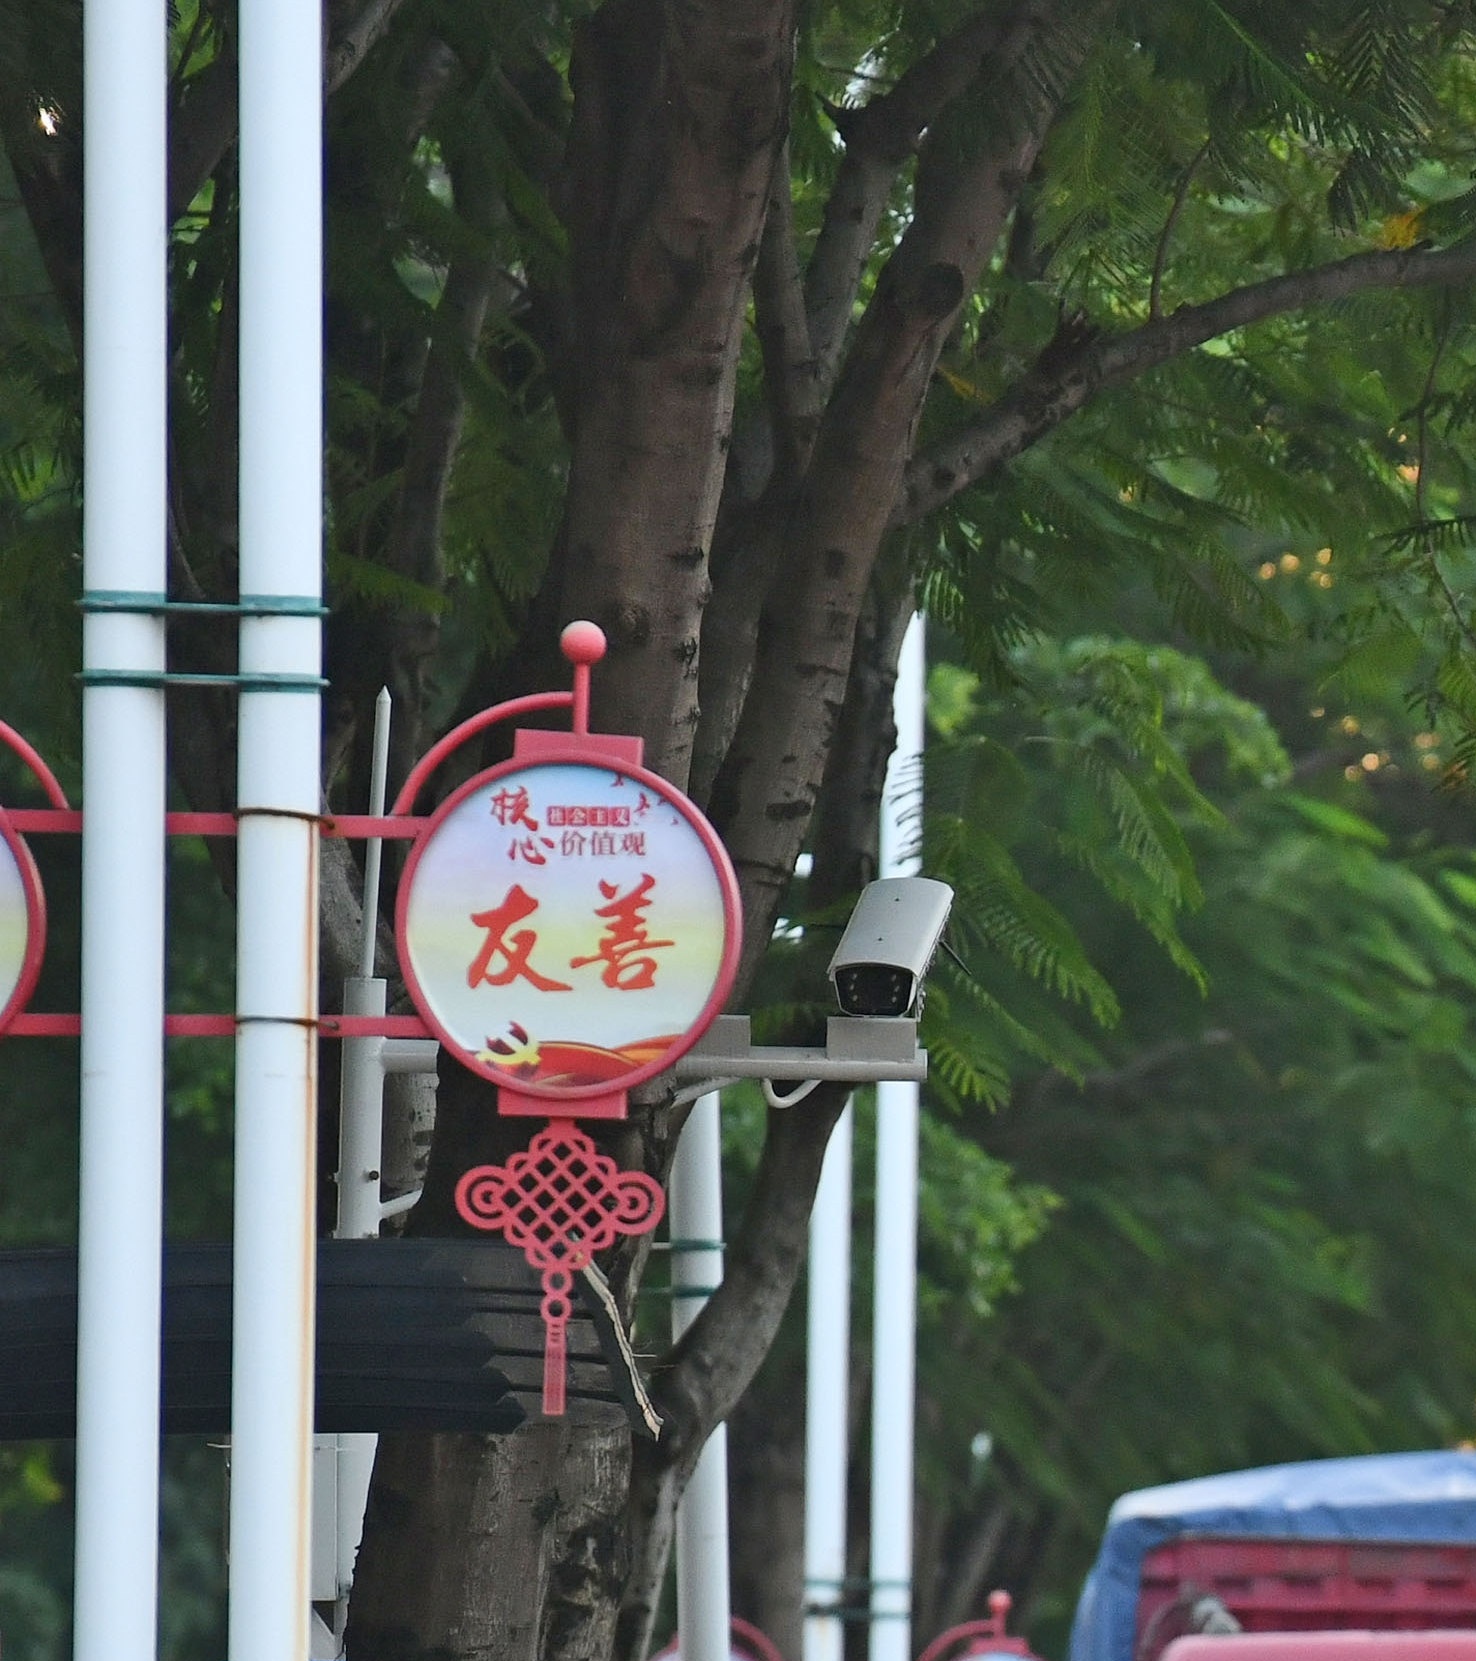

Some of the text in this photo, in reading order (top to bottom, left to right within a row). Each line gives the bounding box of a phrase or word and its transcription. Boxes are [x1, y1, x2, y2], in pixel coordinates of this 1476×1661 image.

[547, 806, 630, 827] 社会主义
[561, 830, 647, 857] 价值观
[467, 872, 675, 992] 友善
